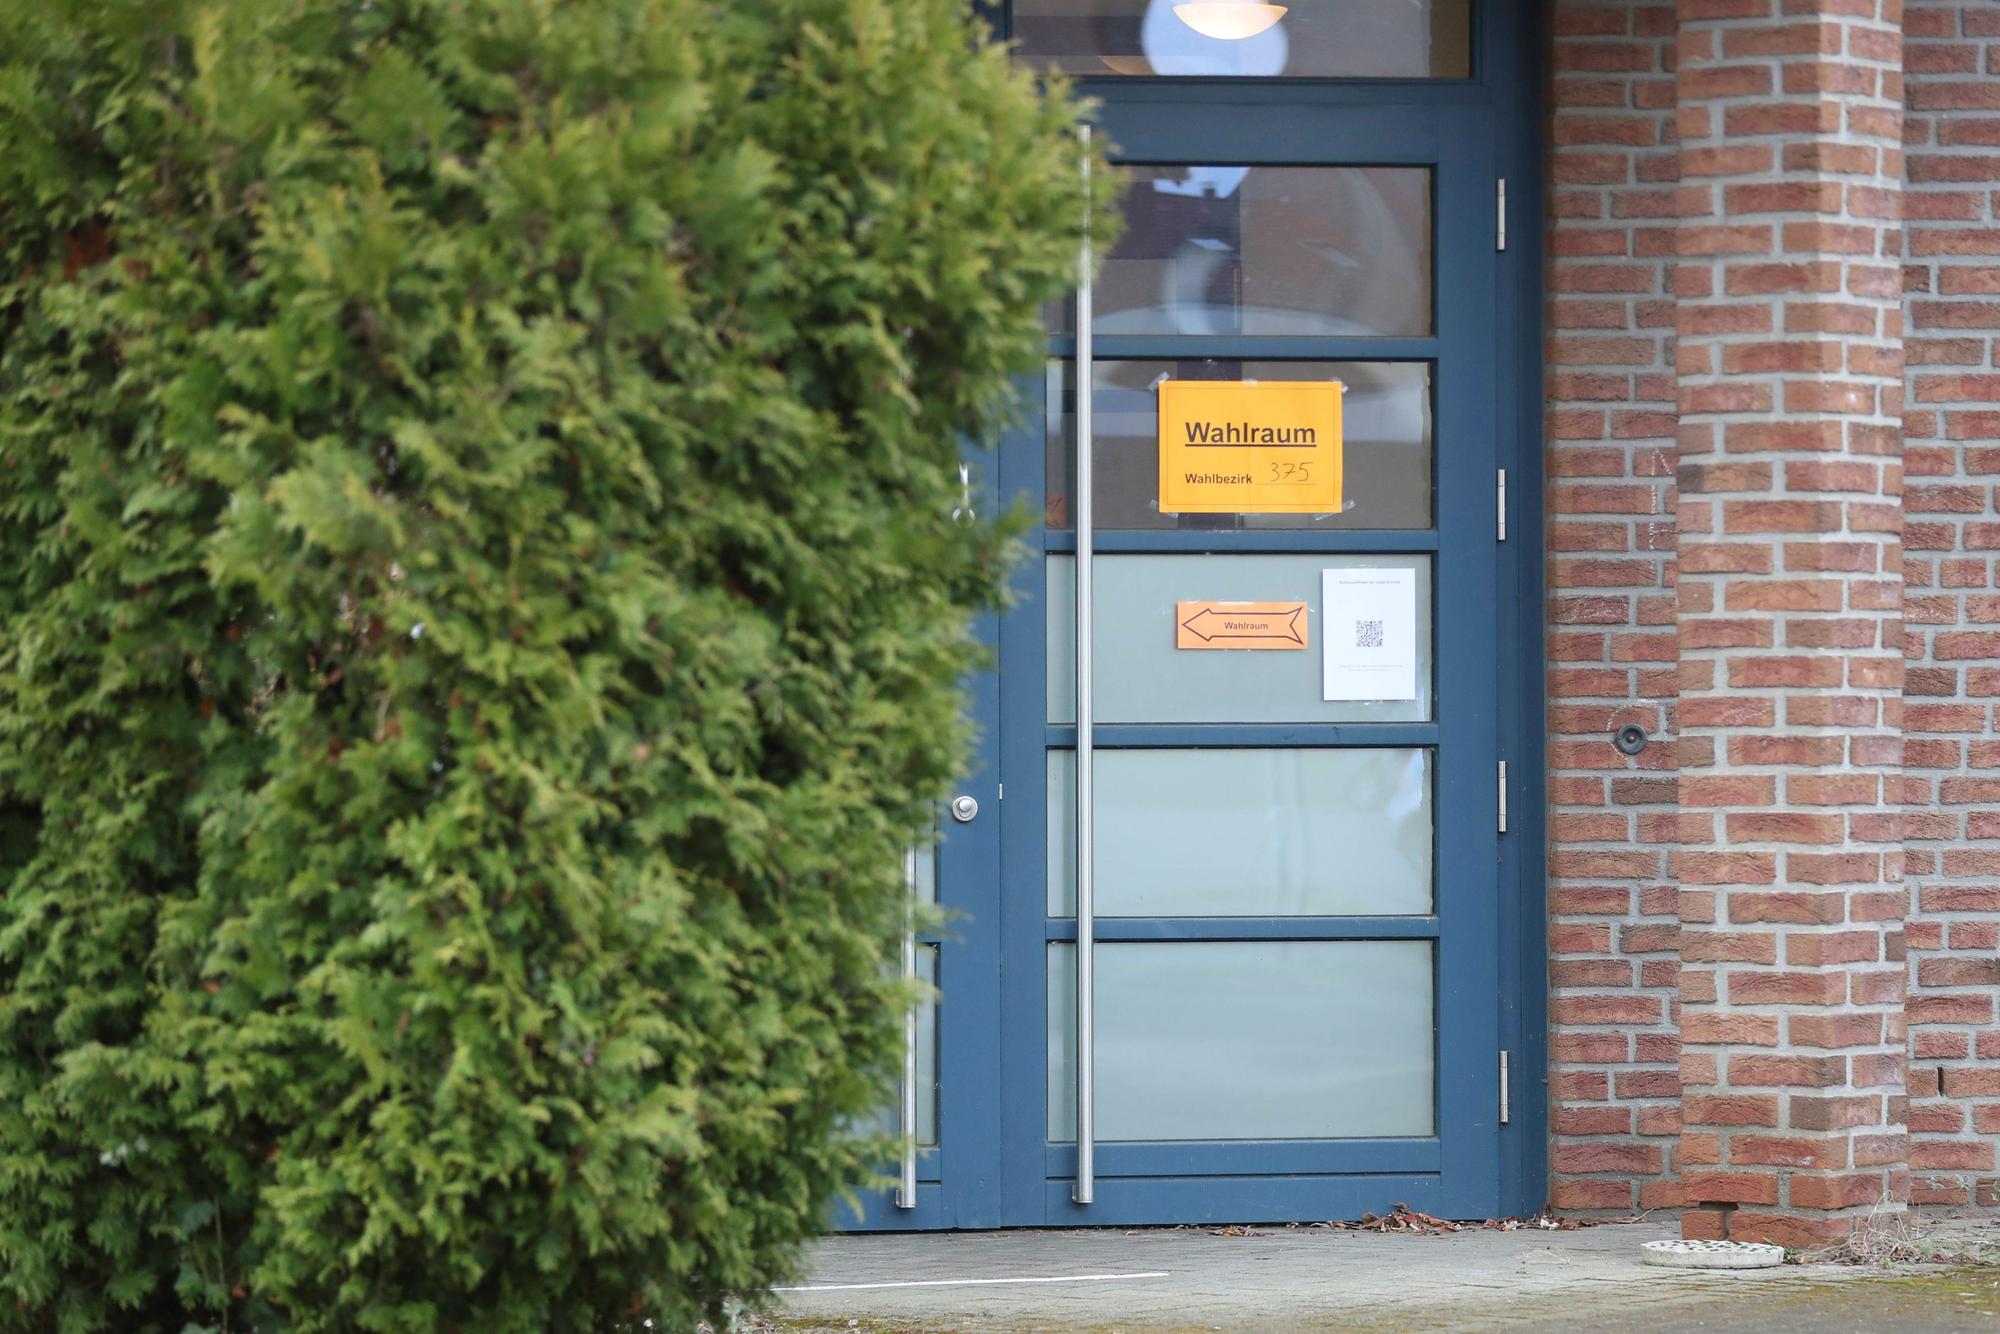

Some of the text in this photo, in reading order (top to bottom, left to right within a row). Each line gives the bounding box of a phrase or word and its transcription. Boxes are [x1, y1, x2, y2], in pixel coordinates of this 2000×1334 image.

[1185, 422, 1315, 443] Wahlraum
[1185, 462, 1314, 484] Wahlbezirk 375
[1224, 621, 1269, 630] Wahlraum
